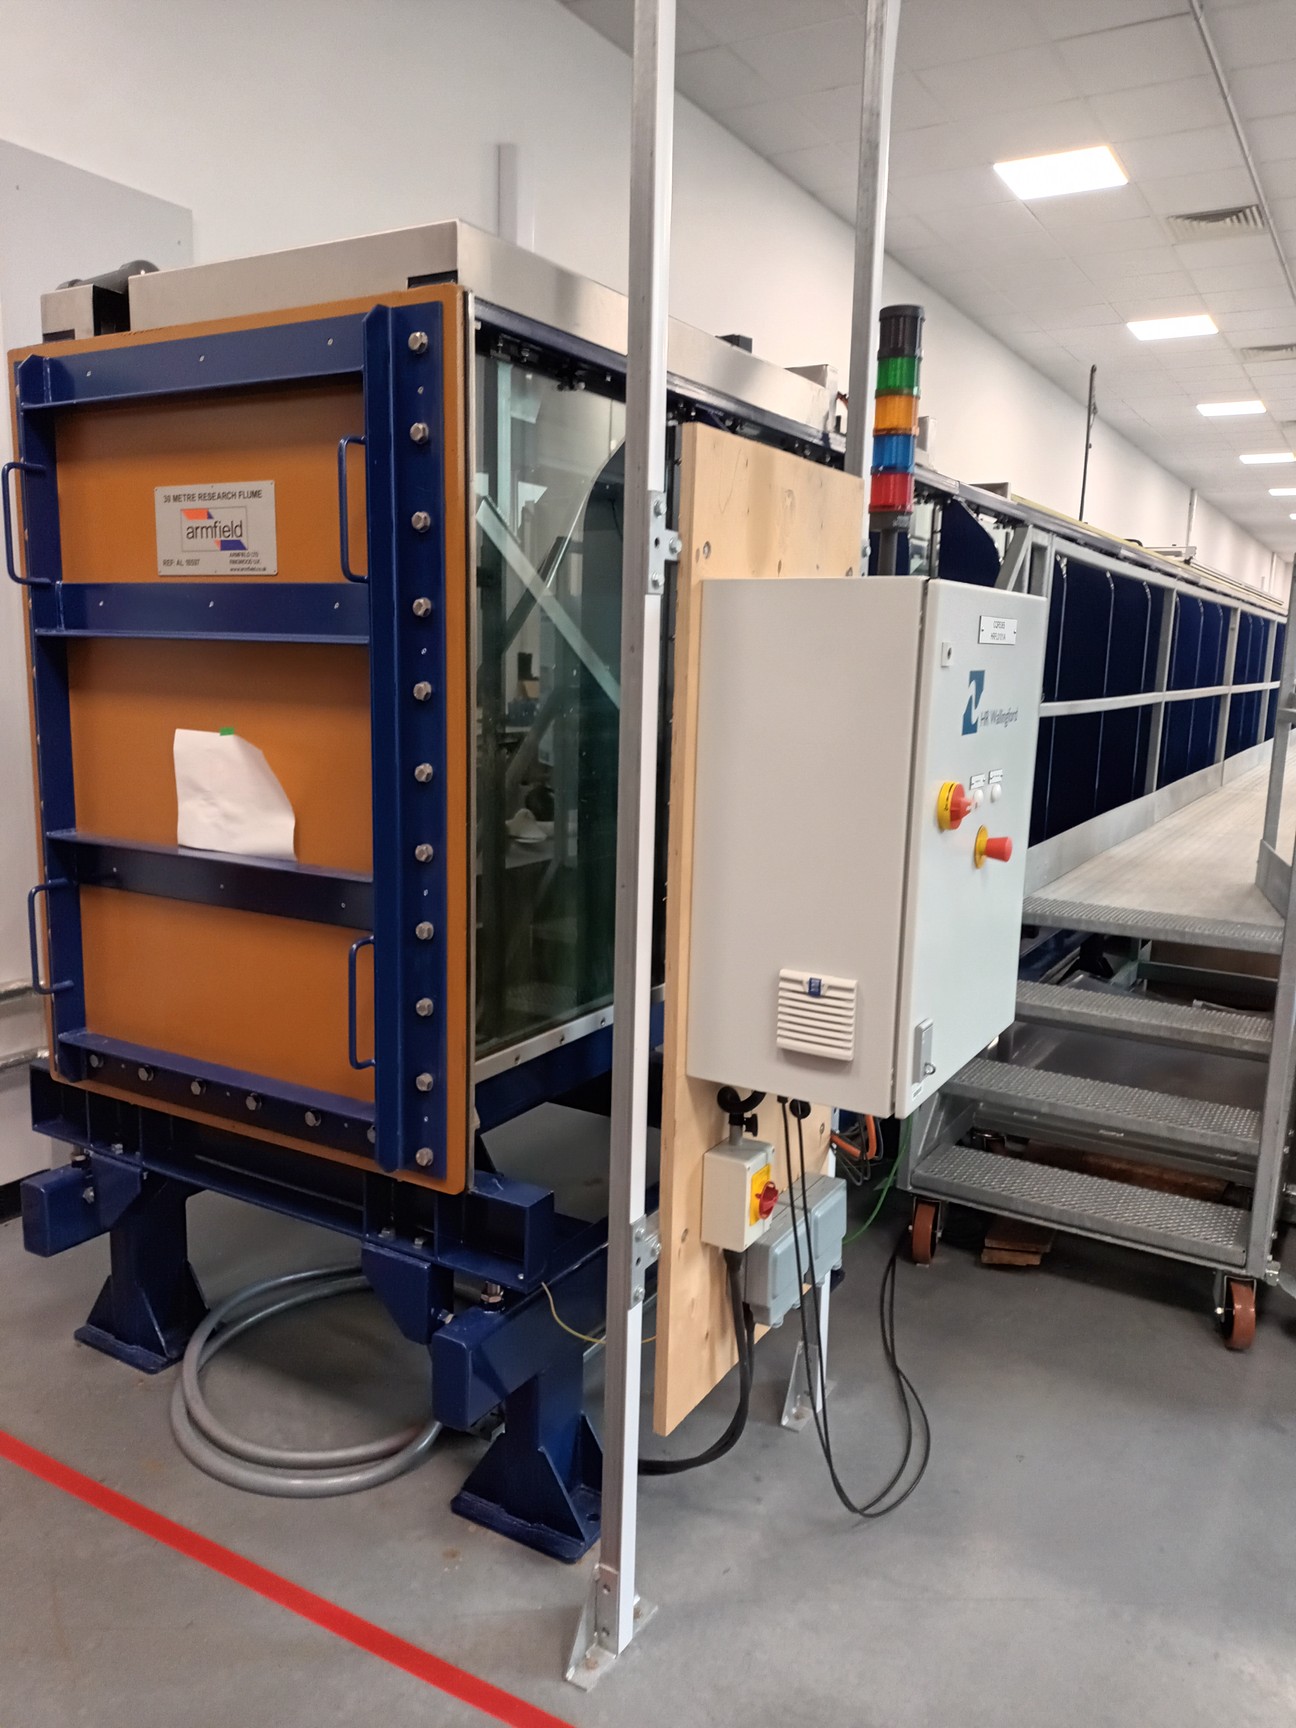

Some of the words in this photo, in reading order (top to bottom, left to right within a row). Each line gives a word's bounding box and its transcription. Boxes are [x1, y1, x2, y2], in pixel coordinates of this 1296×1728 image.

[172, 493, 196, 503] METRE
[198, 491, 237, 502] RESEARCH
[238, 489, 263, 500] FLUME
[186, 520, 243, 540] armfield
[990, 707, 1019, 729] Wallingford
